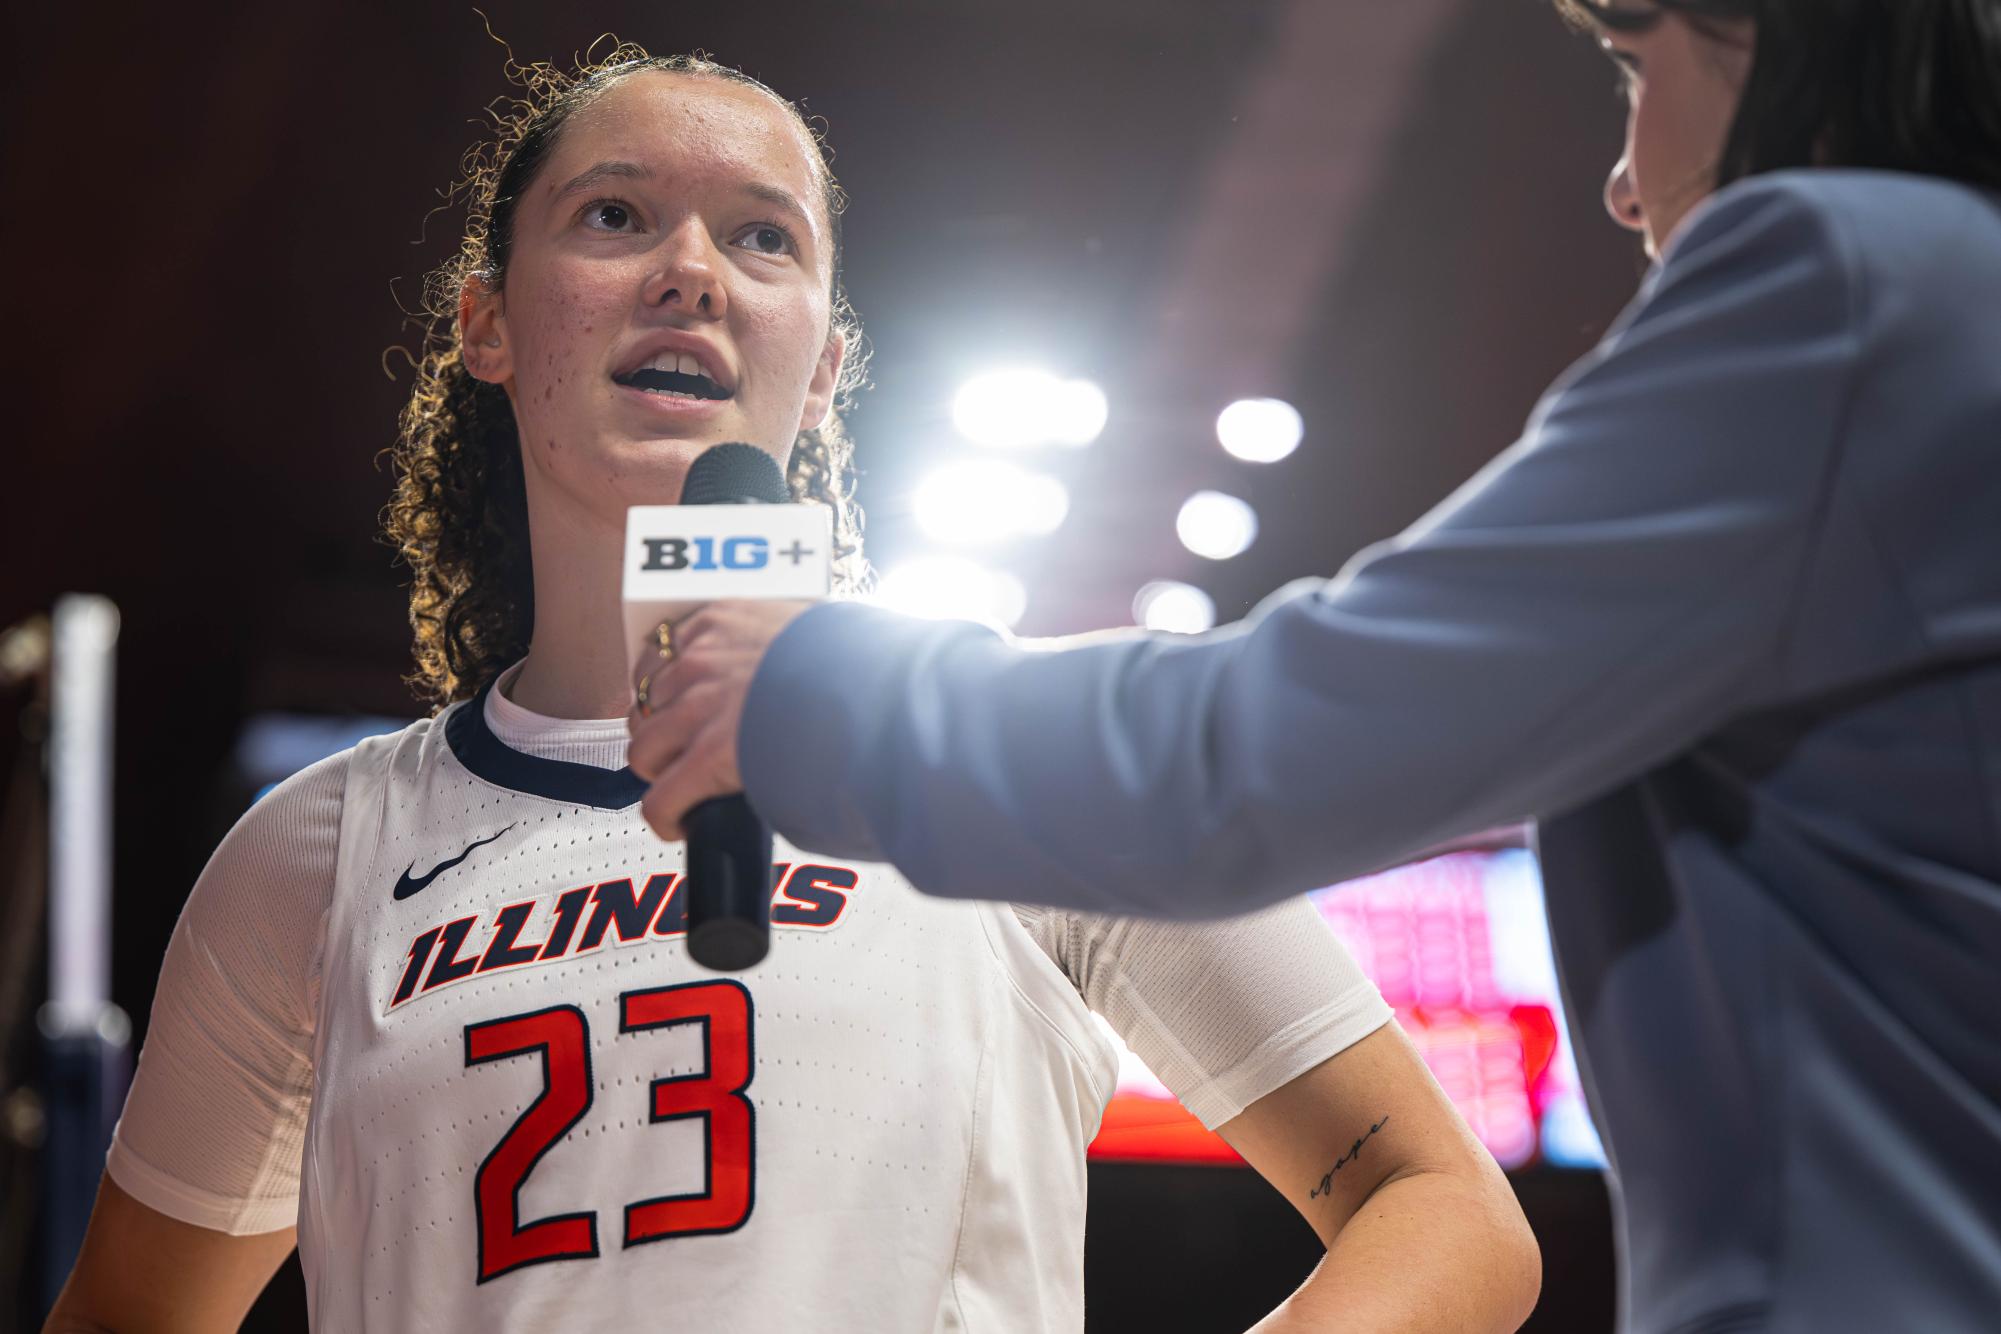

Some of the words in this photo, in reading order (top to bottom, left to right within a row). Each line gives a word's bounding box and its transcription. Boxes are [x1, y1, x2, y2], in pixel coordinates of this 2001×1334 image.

[391, 862, 859, 1008] ILLINS
[464, 978, 755, 1286] 23
[1310, 1115, 1389, 1199] agape
